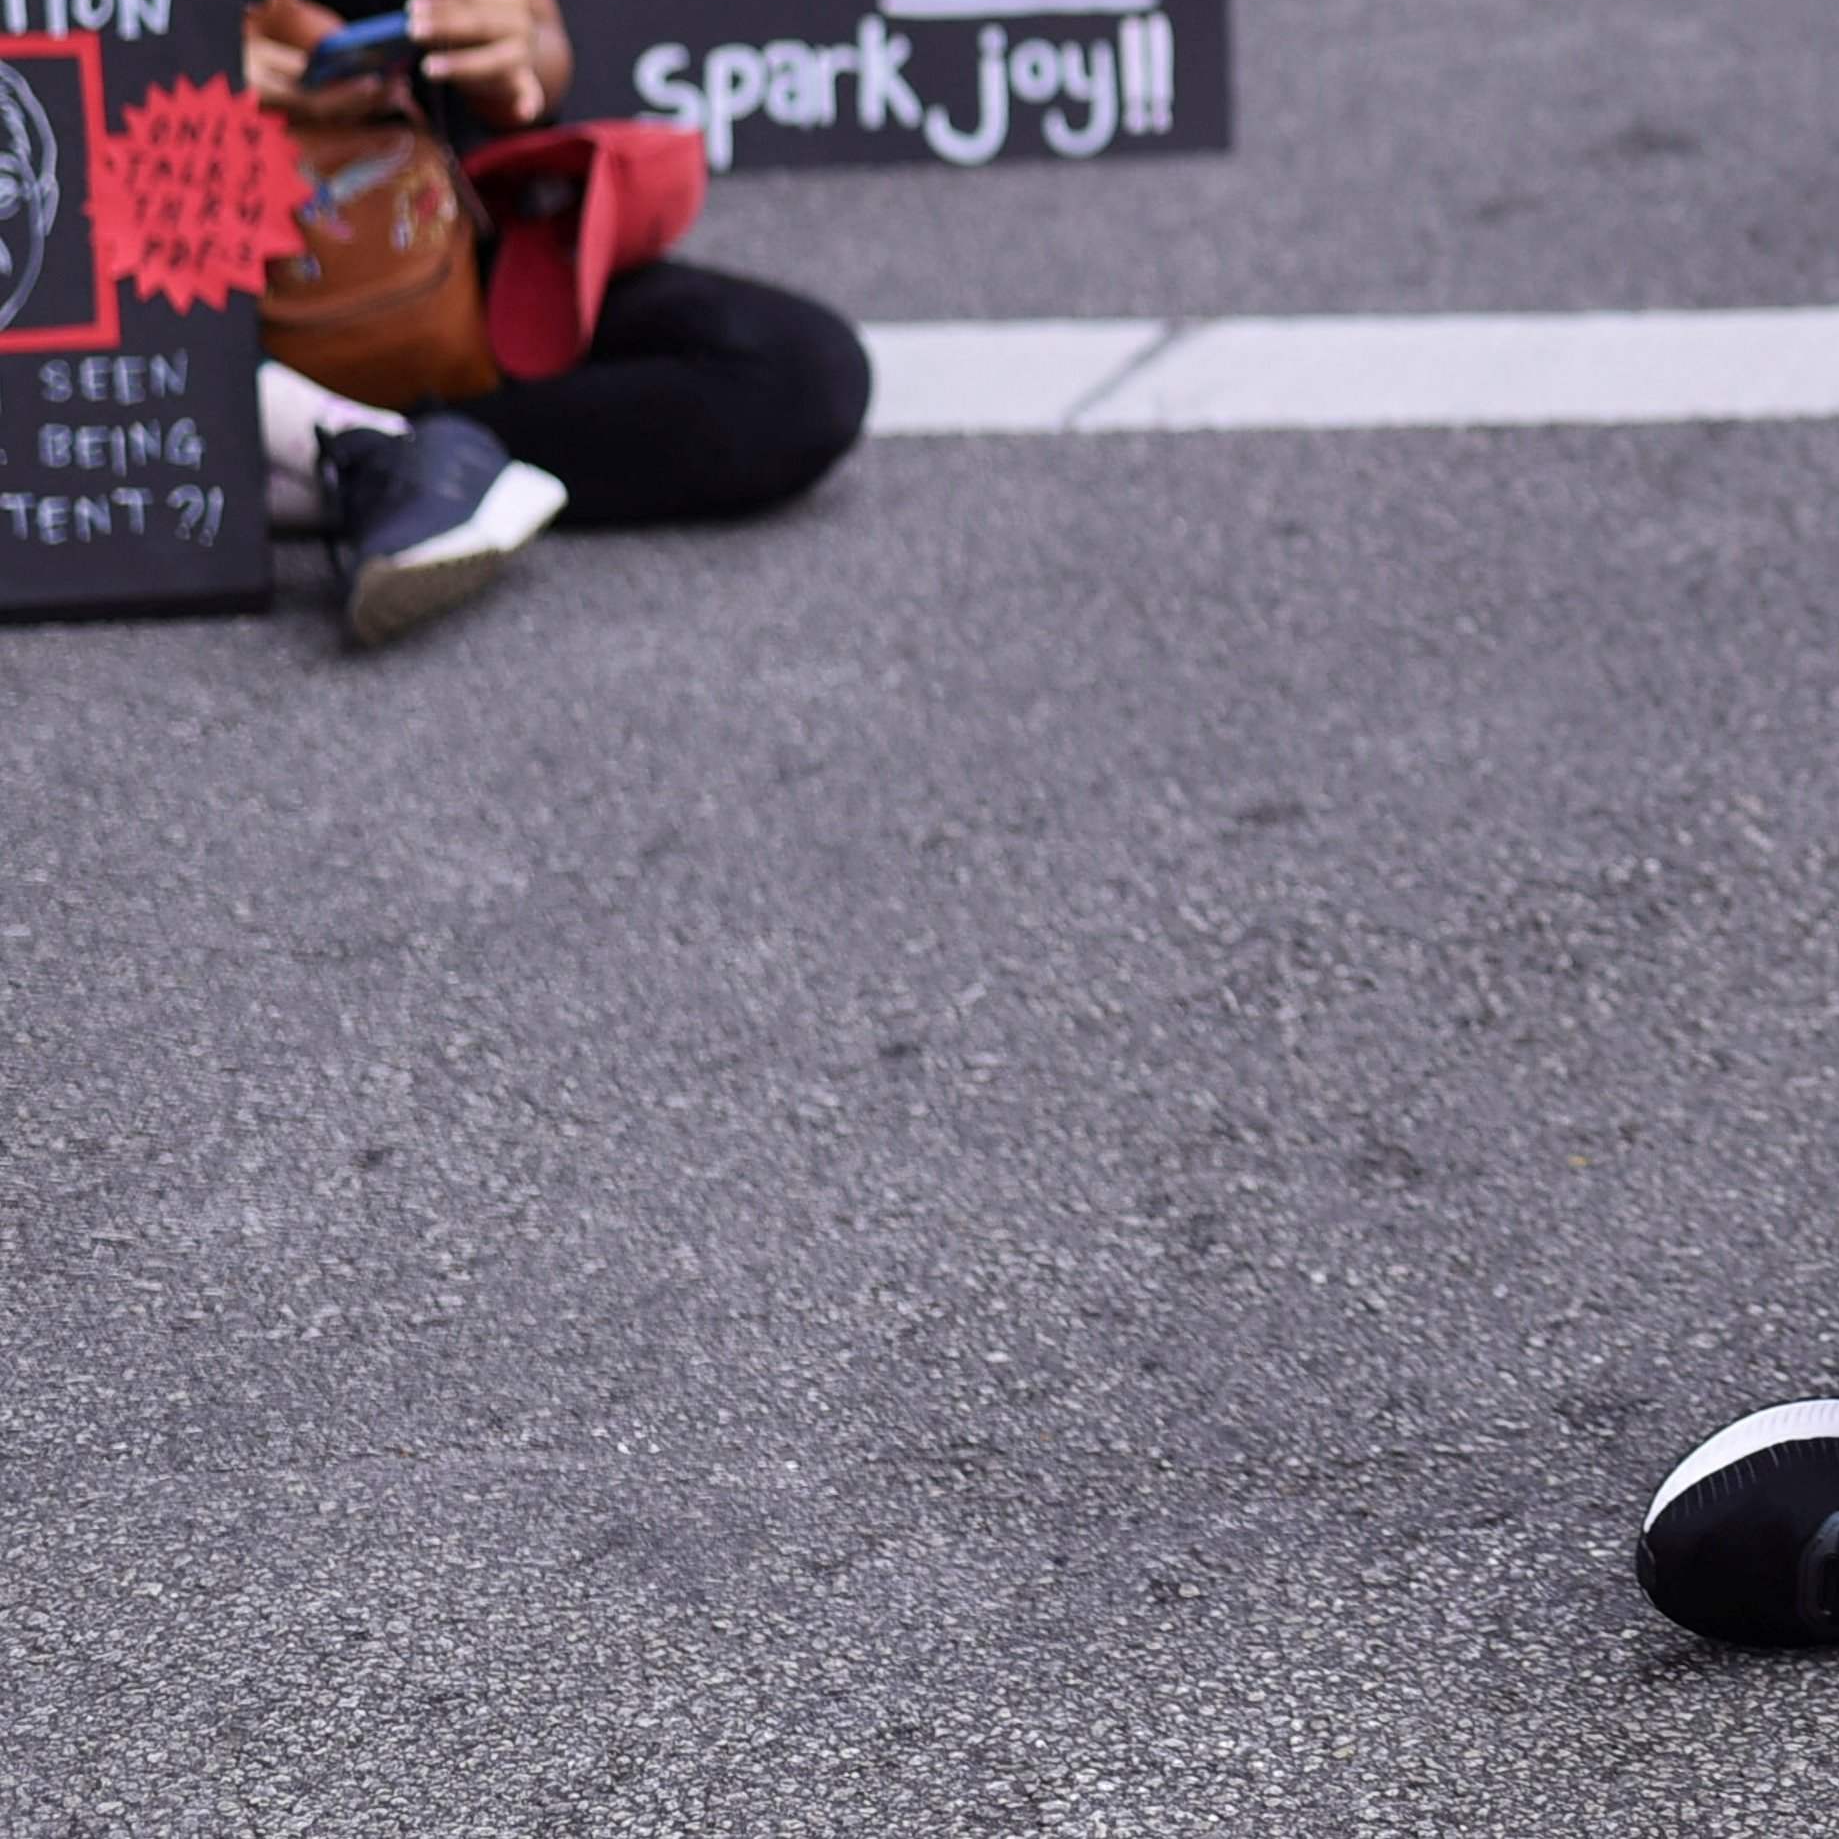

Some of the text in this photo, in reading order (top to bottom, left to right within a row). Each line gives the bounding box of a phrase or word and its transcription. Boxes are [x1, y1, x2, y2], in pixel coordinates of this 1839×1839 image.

[634, 14, 923, 171] spark
[39, 348, 188, 406] SEEN
[37, 418, 206, 477] BEING
